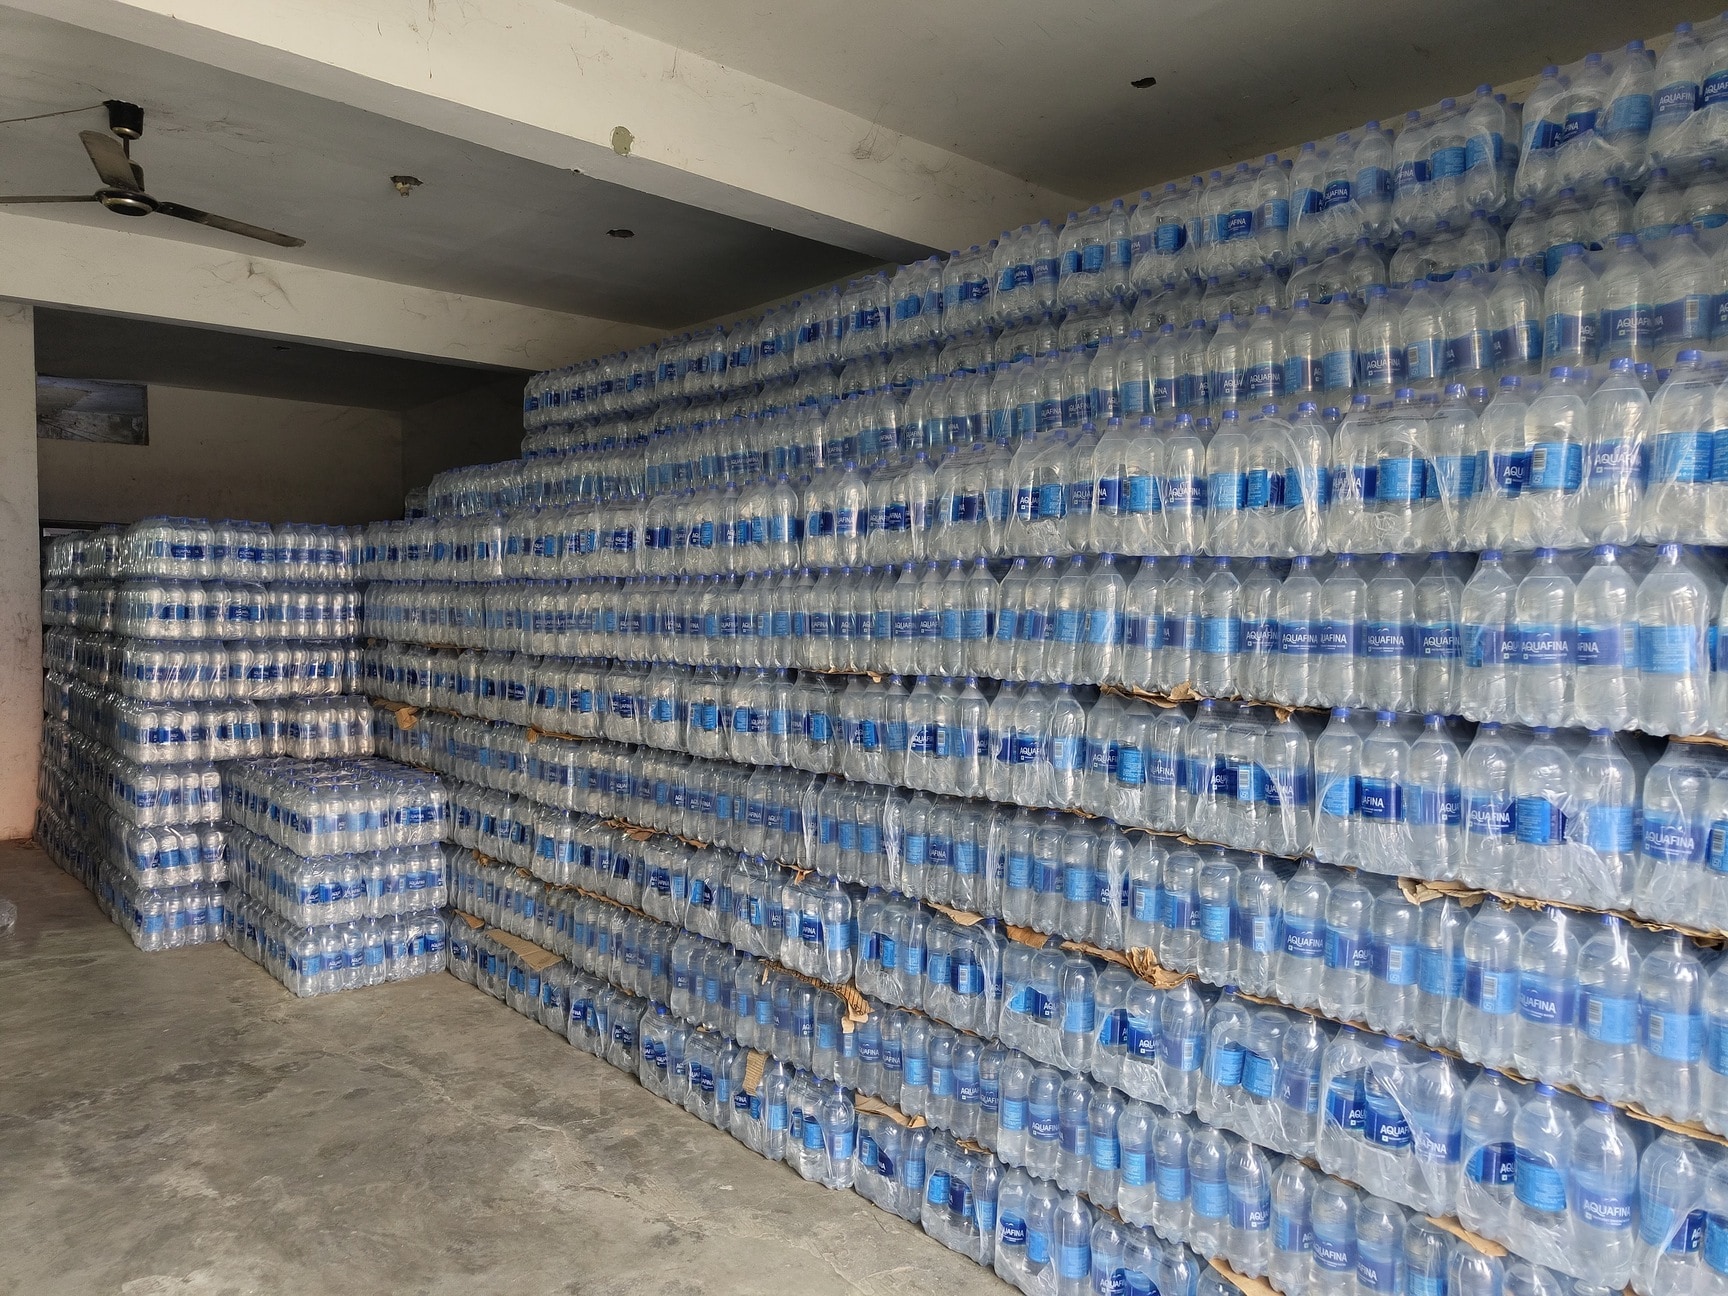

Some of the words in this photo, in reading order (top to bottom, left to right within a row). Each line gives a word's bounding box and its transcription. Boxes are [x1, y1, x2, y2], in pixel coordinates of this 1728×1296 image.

[1659, 92, 1692, 106] AQUAFIN
[1246, 631, 1277, 640] AQUAFIN
[1321, 634, 1347, 644] UAFINA
[1424, 636, 1460, 648] AQUAFIN
[1522, 640, 1568, 652] AQUAFINA
[1578, 642, 1600, 653] FINA
[1472, 810, 1510, 824] QUAFINA
[1288, 934, 1323, 948] AQUAFINA
[1380, 1125, 1409, 1138] AQUAF
[1002, 1227, 1024, 1237] UAFINA
